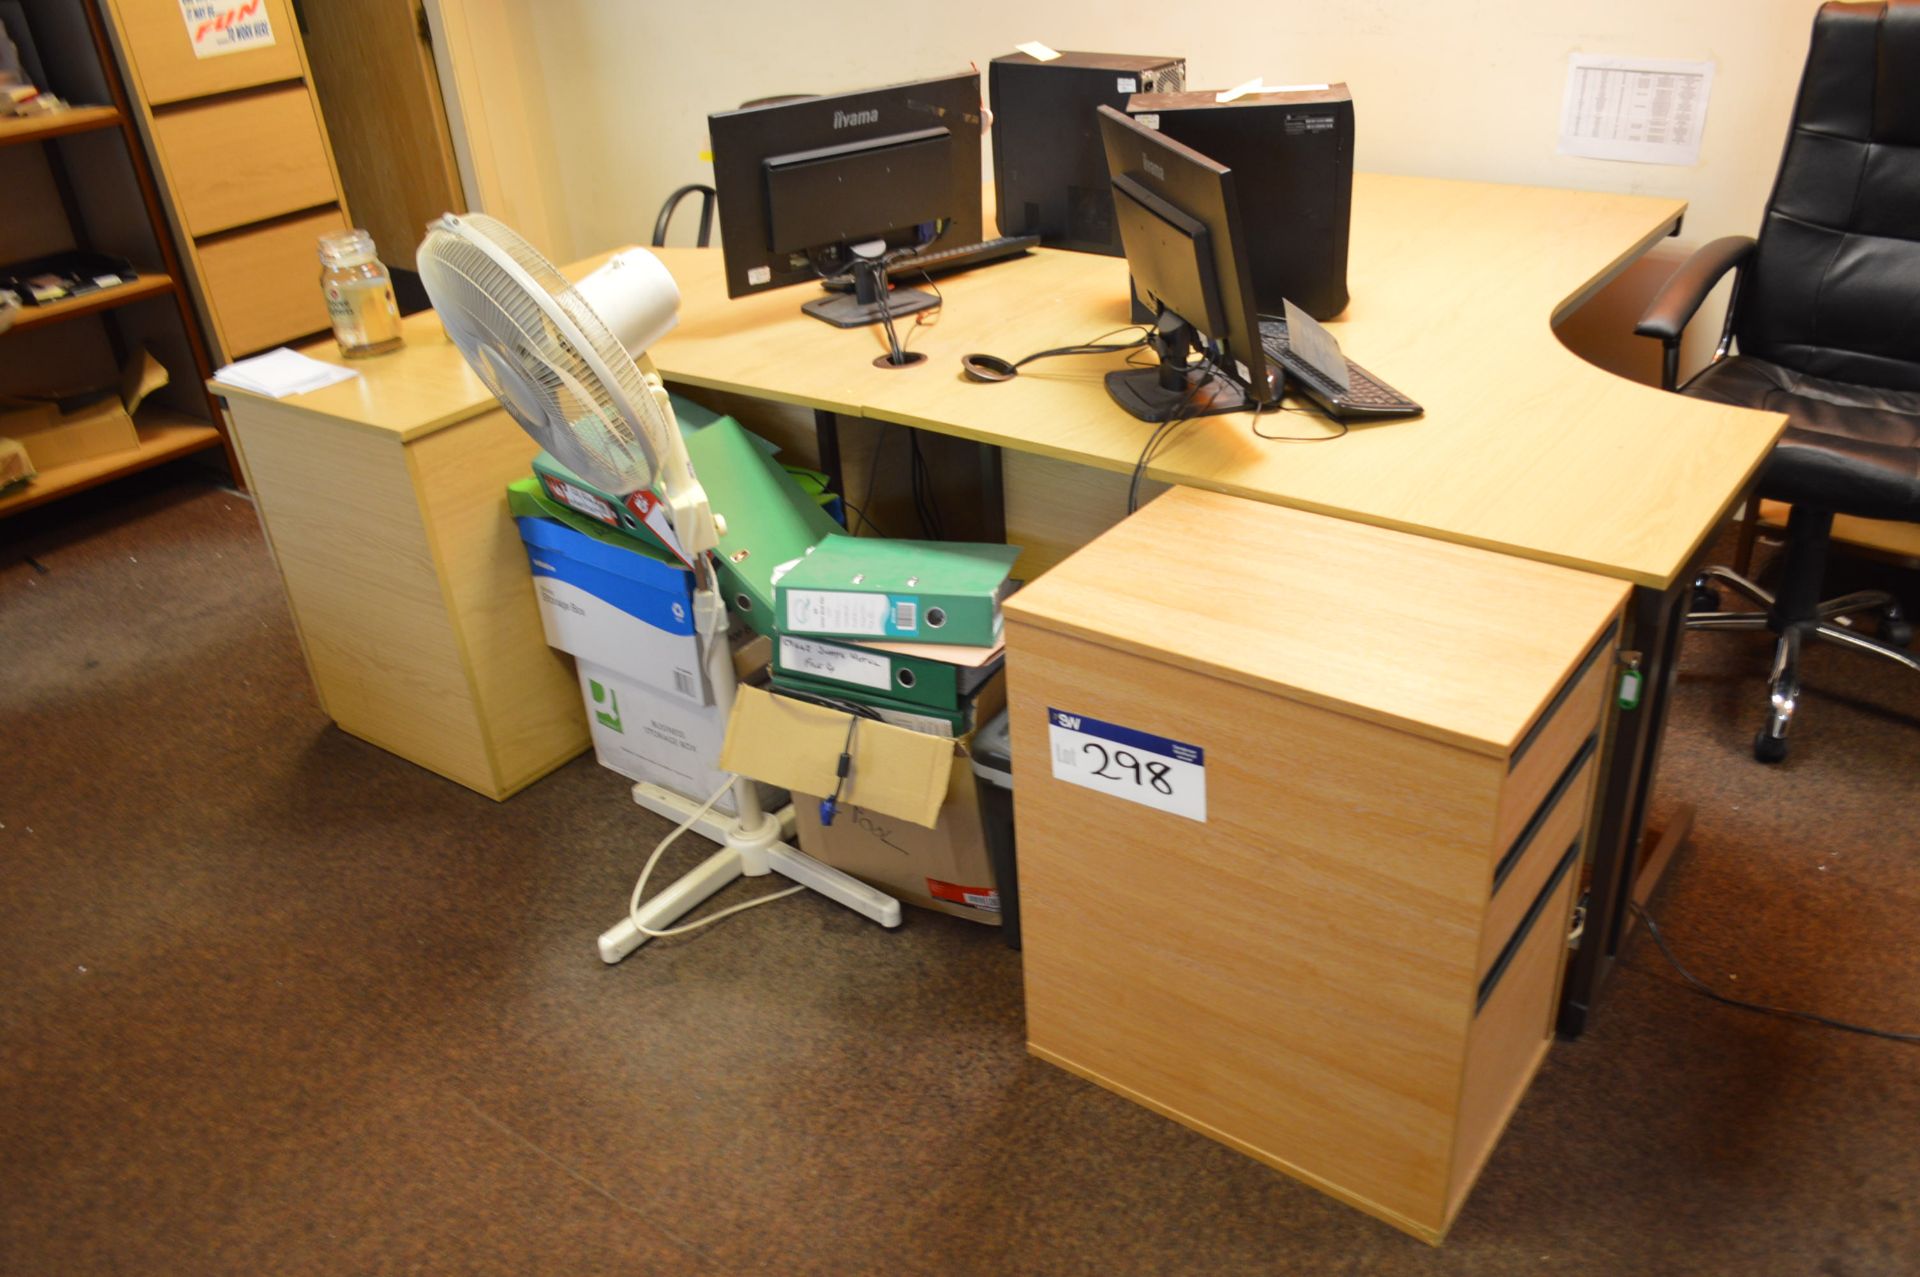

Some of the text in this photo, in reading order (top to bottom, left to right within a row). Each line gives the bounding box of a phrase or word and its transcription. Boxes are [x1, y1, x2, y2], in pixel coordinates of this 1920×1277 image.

[195, 0, 259, 43] FUN
[833, 108, 879, 130] iiyama
[1083, 743, 1173, 795] 298
